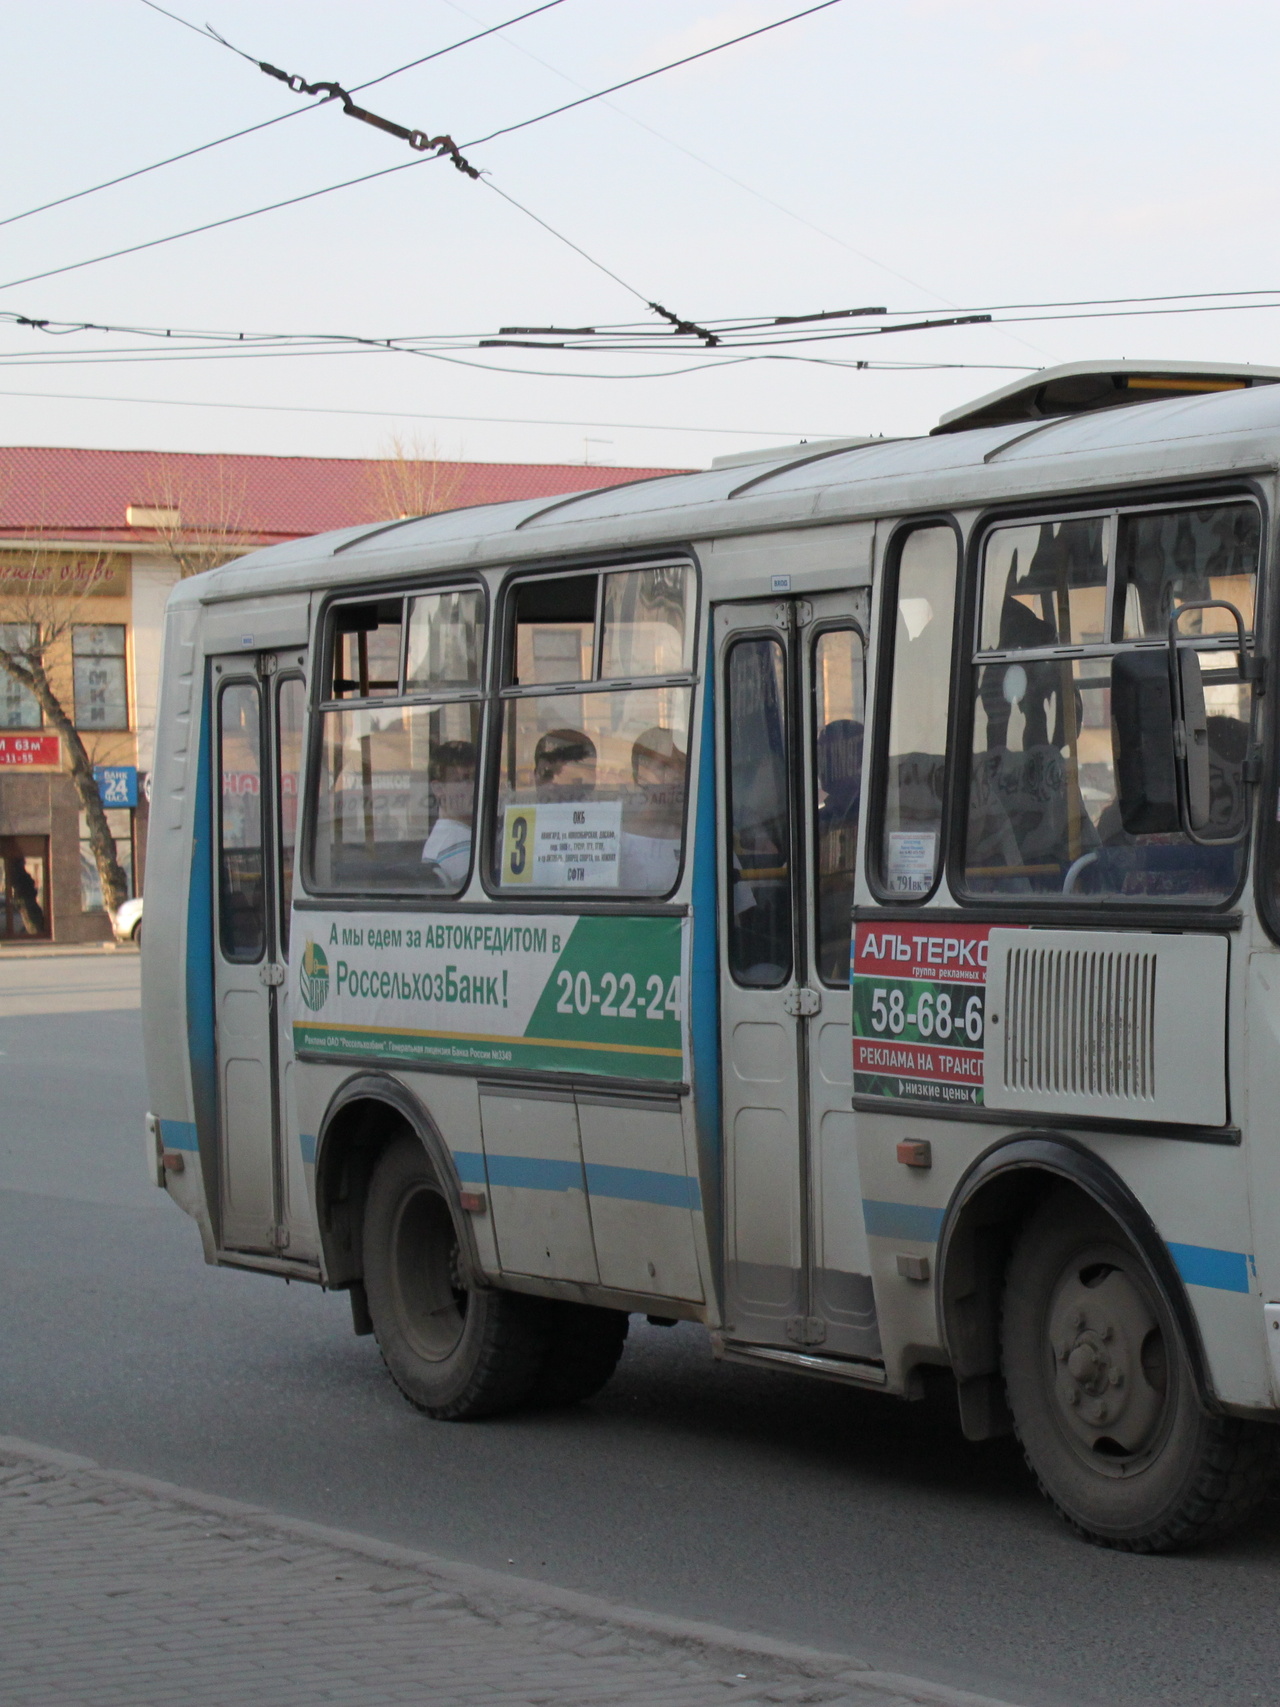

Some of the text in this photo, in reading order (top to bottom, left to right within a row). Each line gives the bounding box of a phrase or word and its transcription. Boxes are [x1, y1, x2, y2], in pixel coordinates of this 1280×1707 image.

[105, 779, 128, 796] 24
[105, 794, 129, 802] ЧАСА
[573, 811, 585, 824] ОКБ
[510, 816, 528, 875] 3
[329, 922, 561, 956] А мы едем за АВТОКРЕДИТОМ в
[336, 960, 508, 1009] РоссельхозБанк!
[912, 966, 936, 978] группа
[938, 968, 980, 981] рекламных
[556, 969, 682, 1021] 20-22-24
[871, 988, 983, 1042] 58-68-6
[860, 1046, 915, 1070] РЕКЛАМА
[917, 1054, 934, 1072] НА
[905, 1082, 969, 1101] низкие цены
